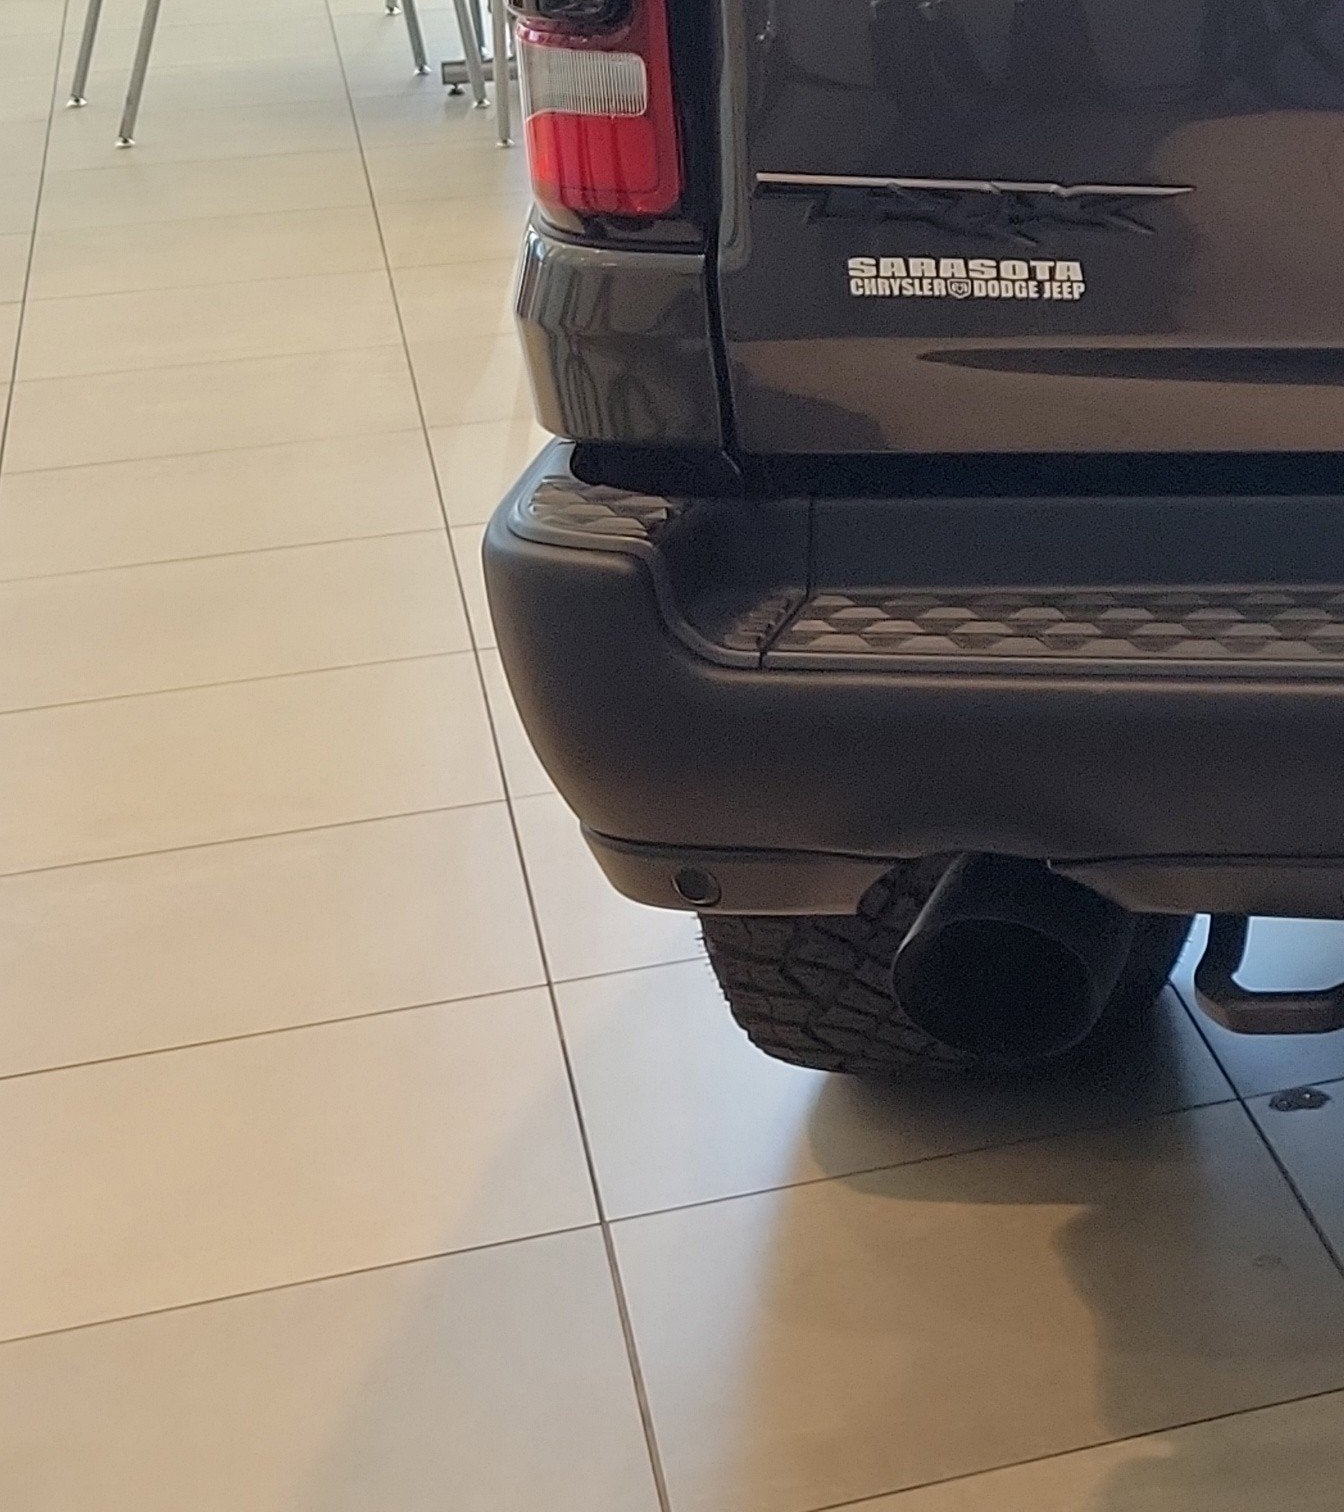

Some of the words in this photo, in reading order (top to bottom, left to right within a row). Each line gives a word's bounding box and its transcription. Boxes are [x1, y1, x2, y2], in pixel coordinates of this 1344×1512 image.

[847, 256, 1084, 282] SARASOTA
[850, 278, 947, 296] CHRYSLER
[973, 281, 1040, 298] DODGE
[1043, 281, 1086, 300] JEEP
